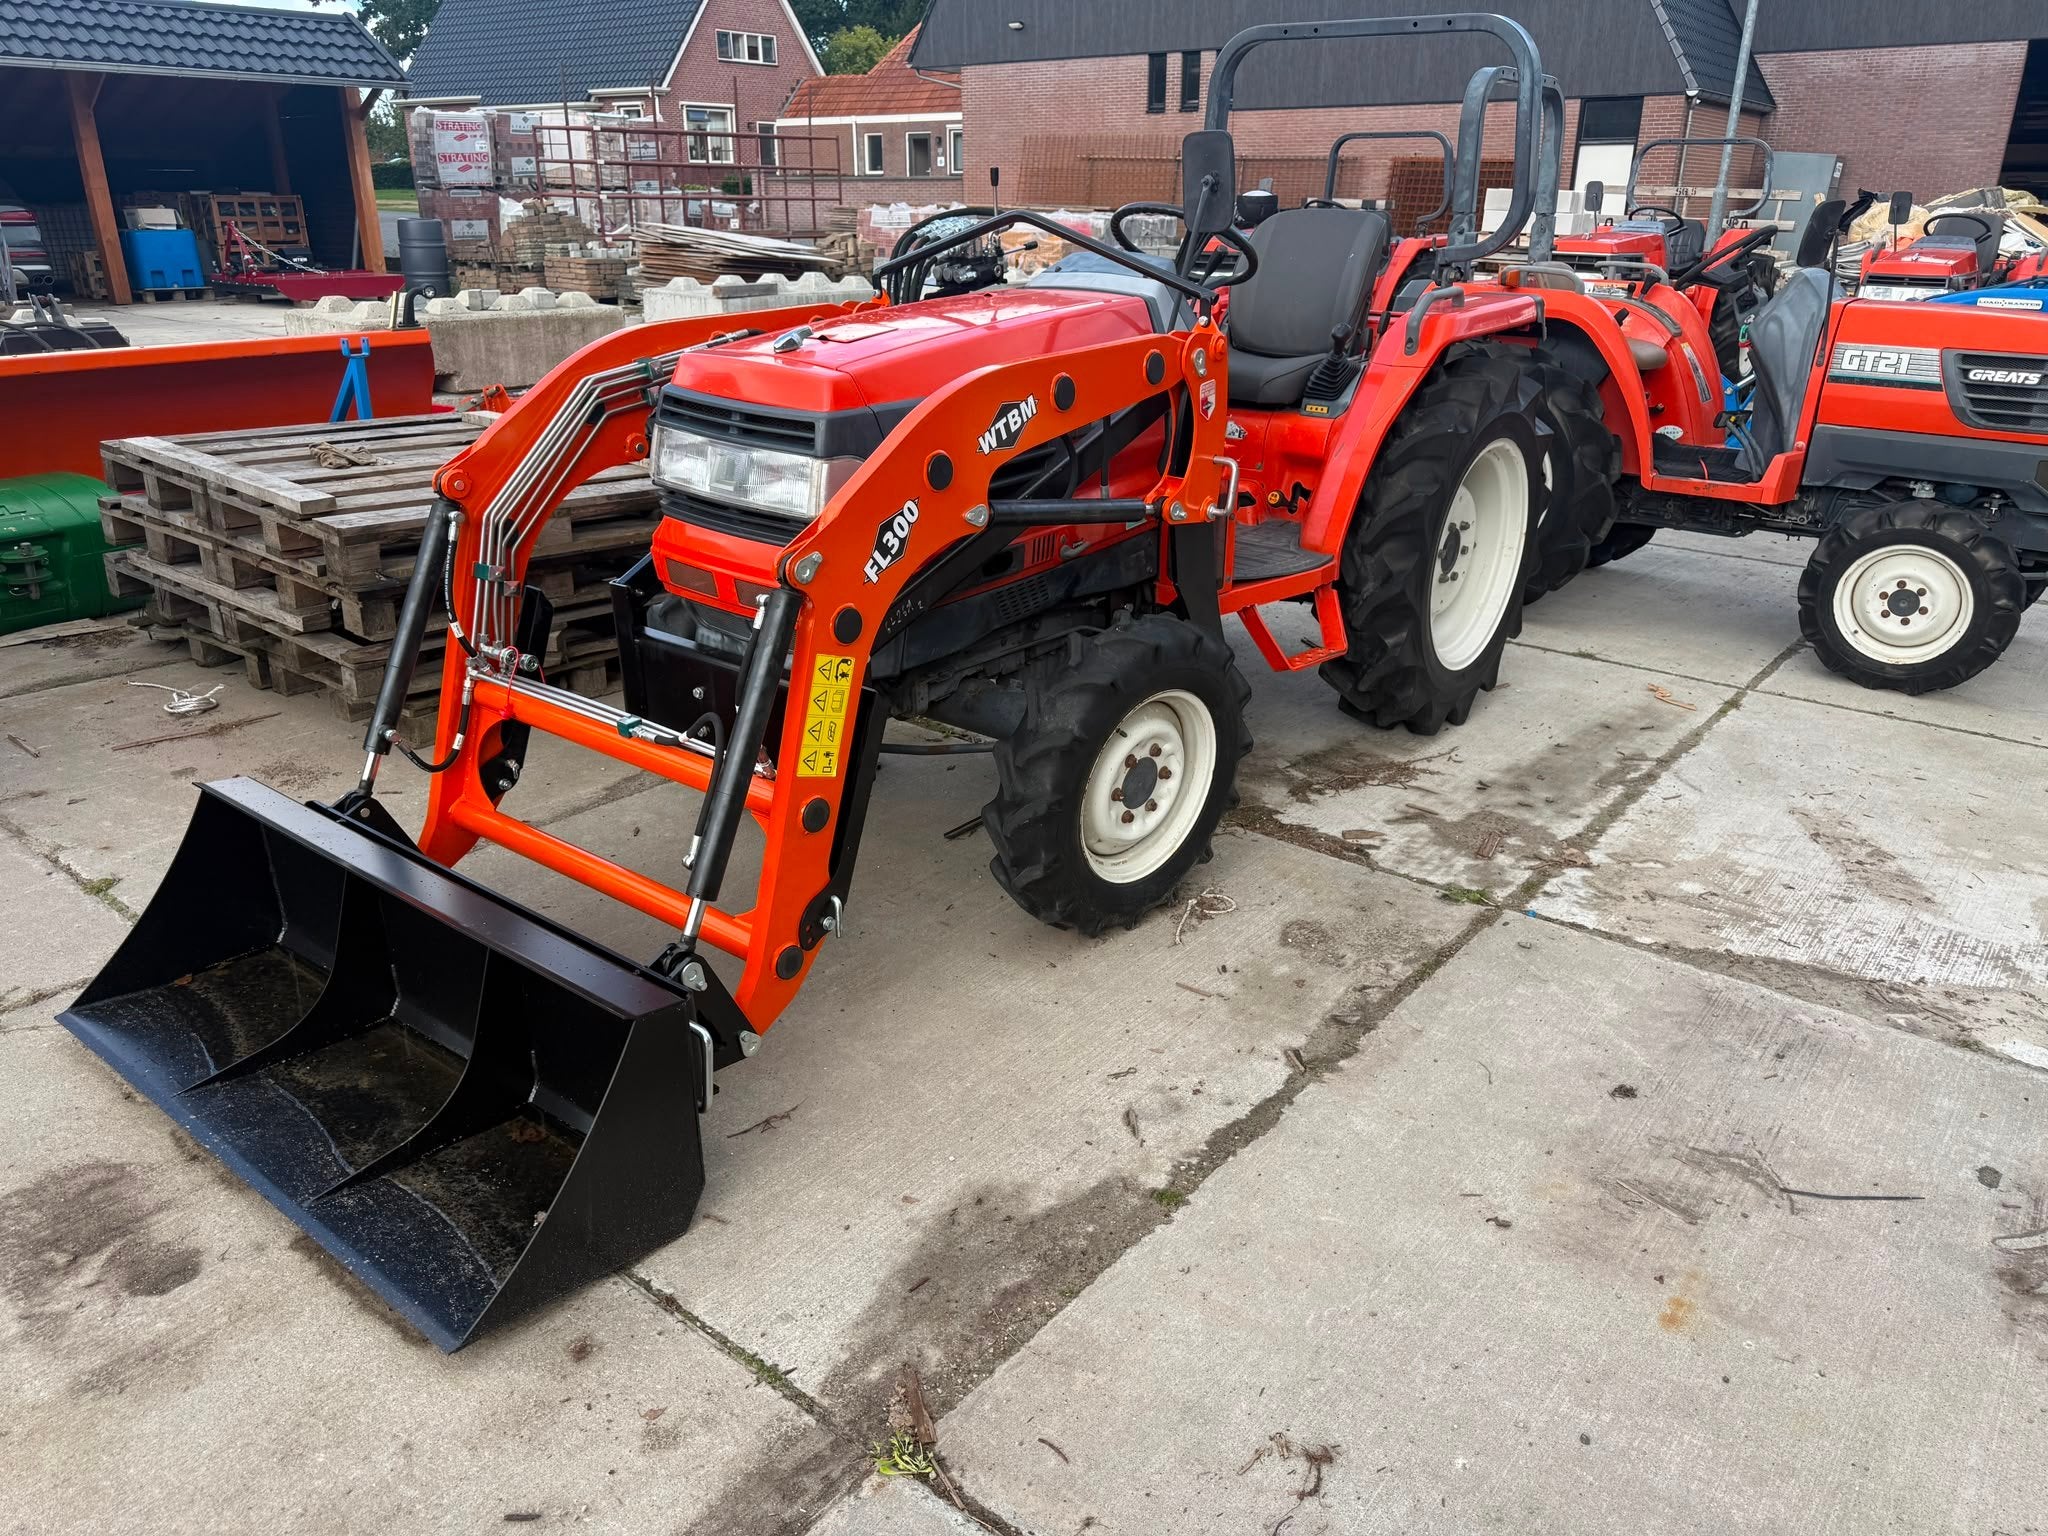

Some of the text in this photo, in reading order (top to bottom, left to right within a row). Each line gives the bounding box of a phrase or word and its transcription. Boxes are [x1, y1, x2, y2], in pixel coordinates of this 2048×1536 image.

[436, 120, 482, 131] STRATING
[438, 152, 489, 162] STRATING
[1841, 349, 1911, 374] GT21
[1968, 369, 2042, 385] GREATS
[978, 394, 1037, 455] WTBM
[863, 499, 919, 584] FL300
